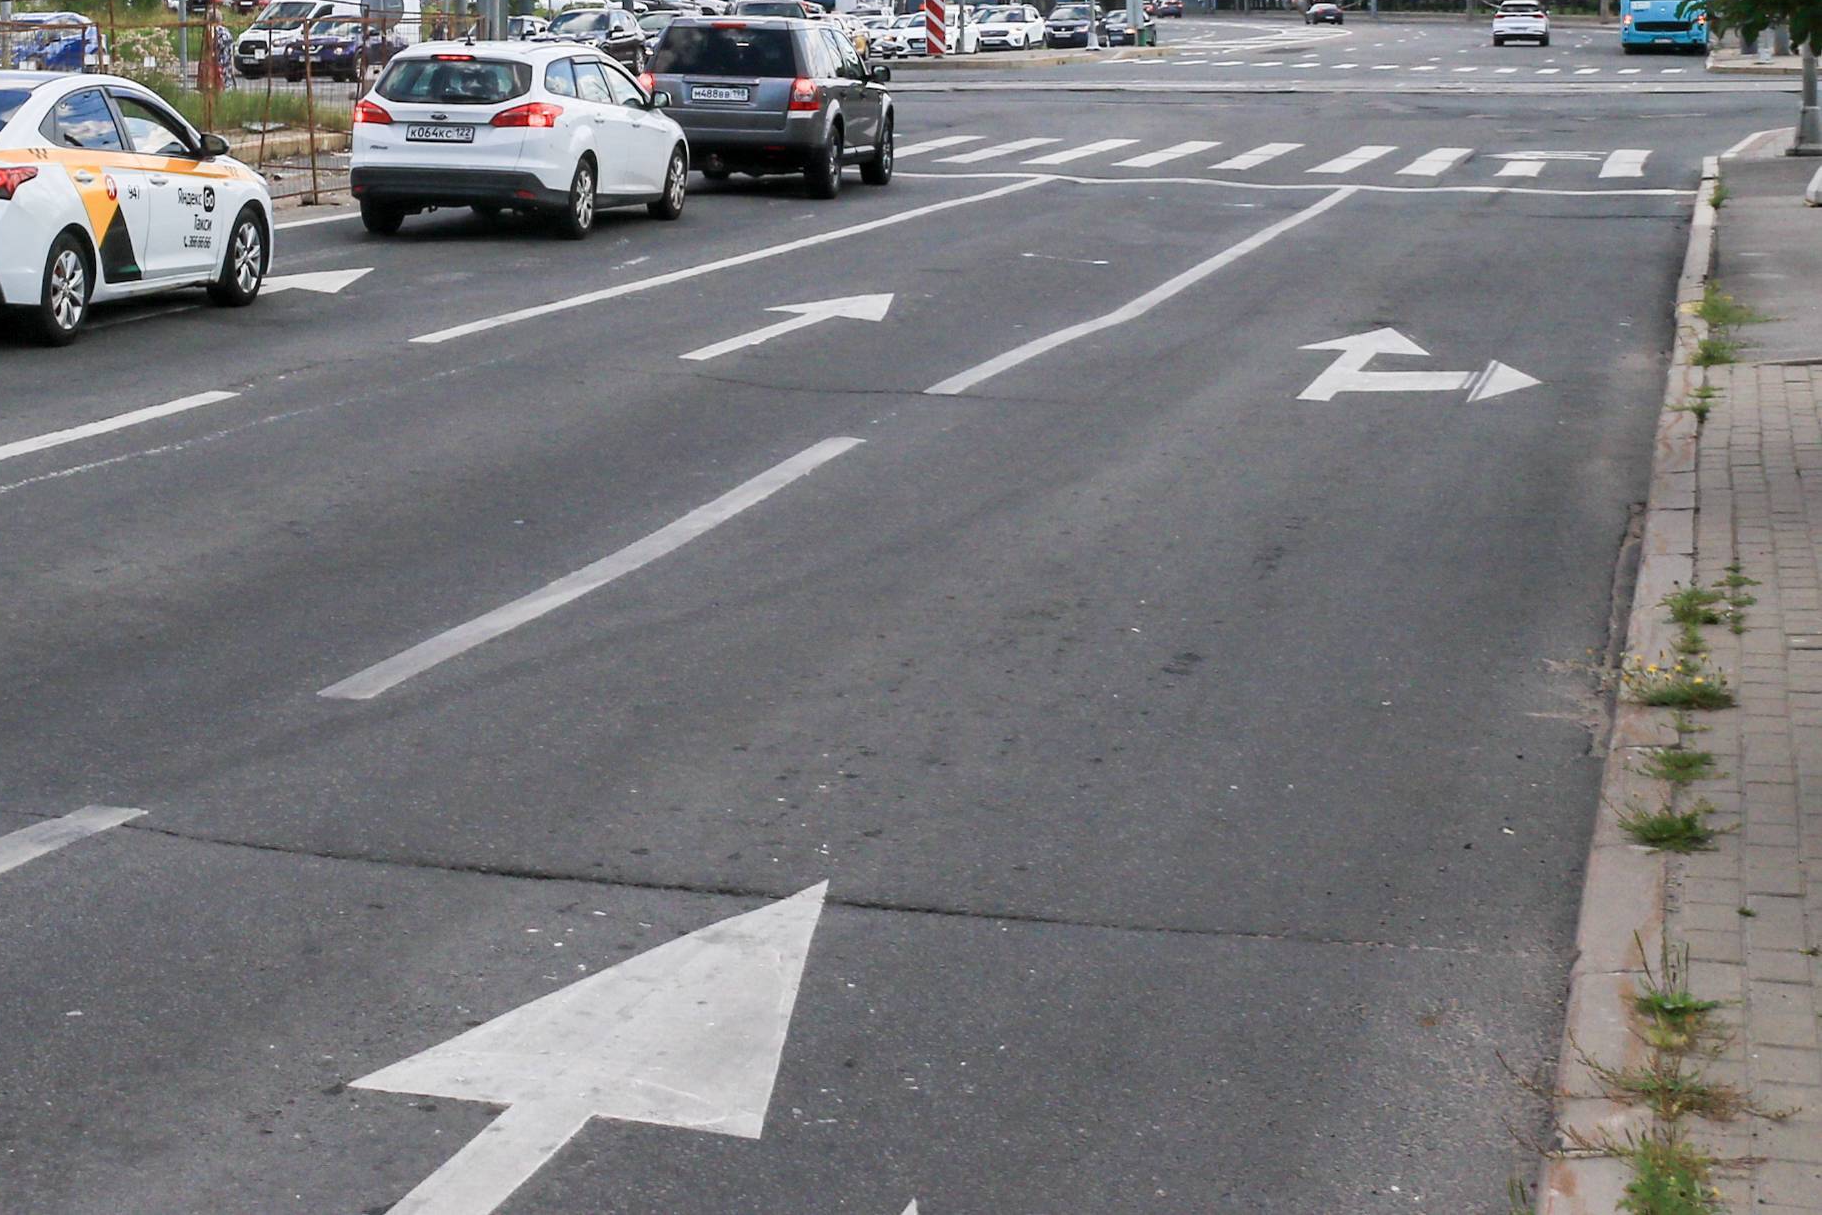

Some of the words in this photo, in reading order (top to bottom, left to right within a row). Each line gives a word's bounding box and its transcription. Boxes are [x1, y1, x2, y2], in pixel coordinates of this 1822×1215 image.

[456, 128, 471, 137] 122
[128, 185, 140, 200] 947
[178, 188, 203, 207] Яндекс
[203, 187, 215, 206] Go
[194, 214, 213, 232] Такси
